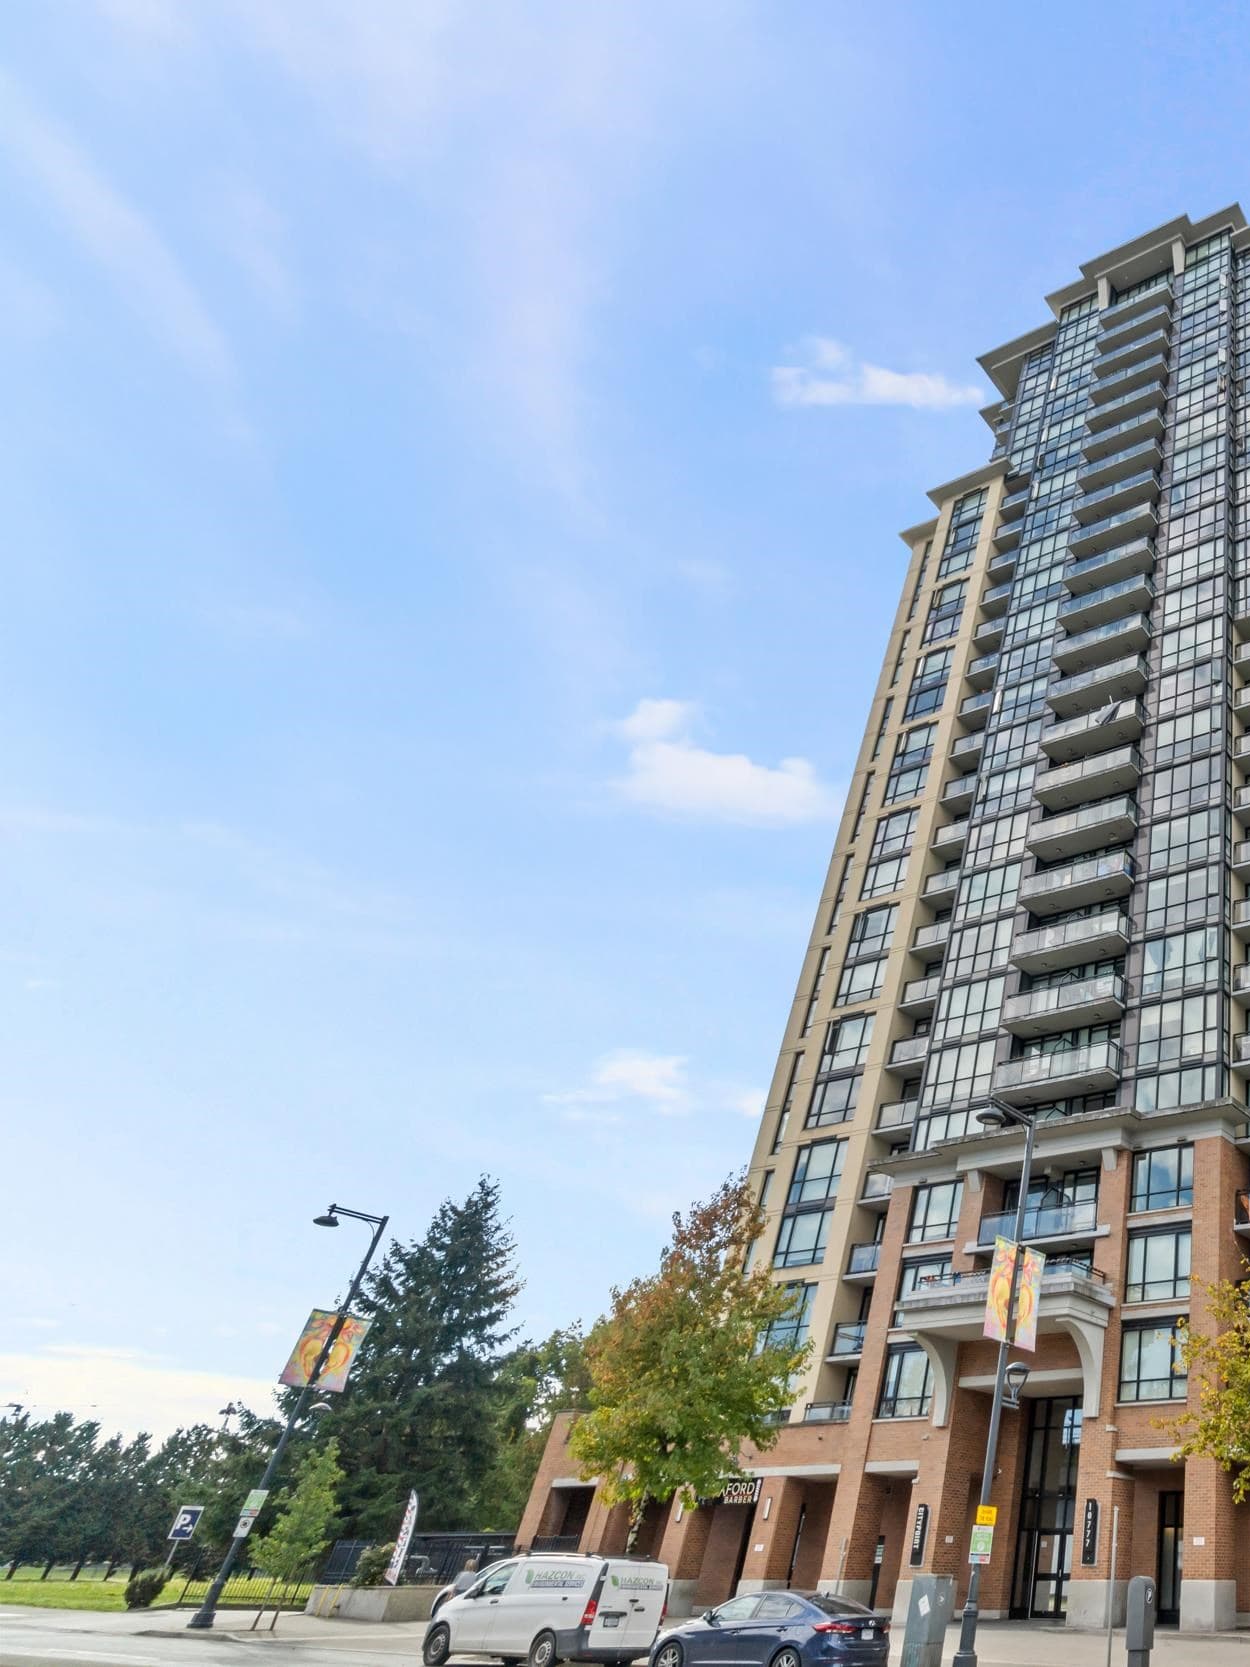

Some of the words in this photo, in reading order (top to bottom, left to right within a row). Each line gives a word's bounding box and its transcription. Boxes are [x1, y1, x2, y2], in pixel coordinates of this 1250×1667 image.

[723, 1495, 753, 1505] BARBER
[912, 1506, 925, 1550] CITYPOINT
[1085, 1502, 1093, 1548] 10777
[534, 1569, 576, 1581] HAZCON
[620, 1576, 656, 1586] HAZCON
